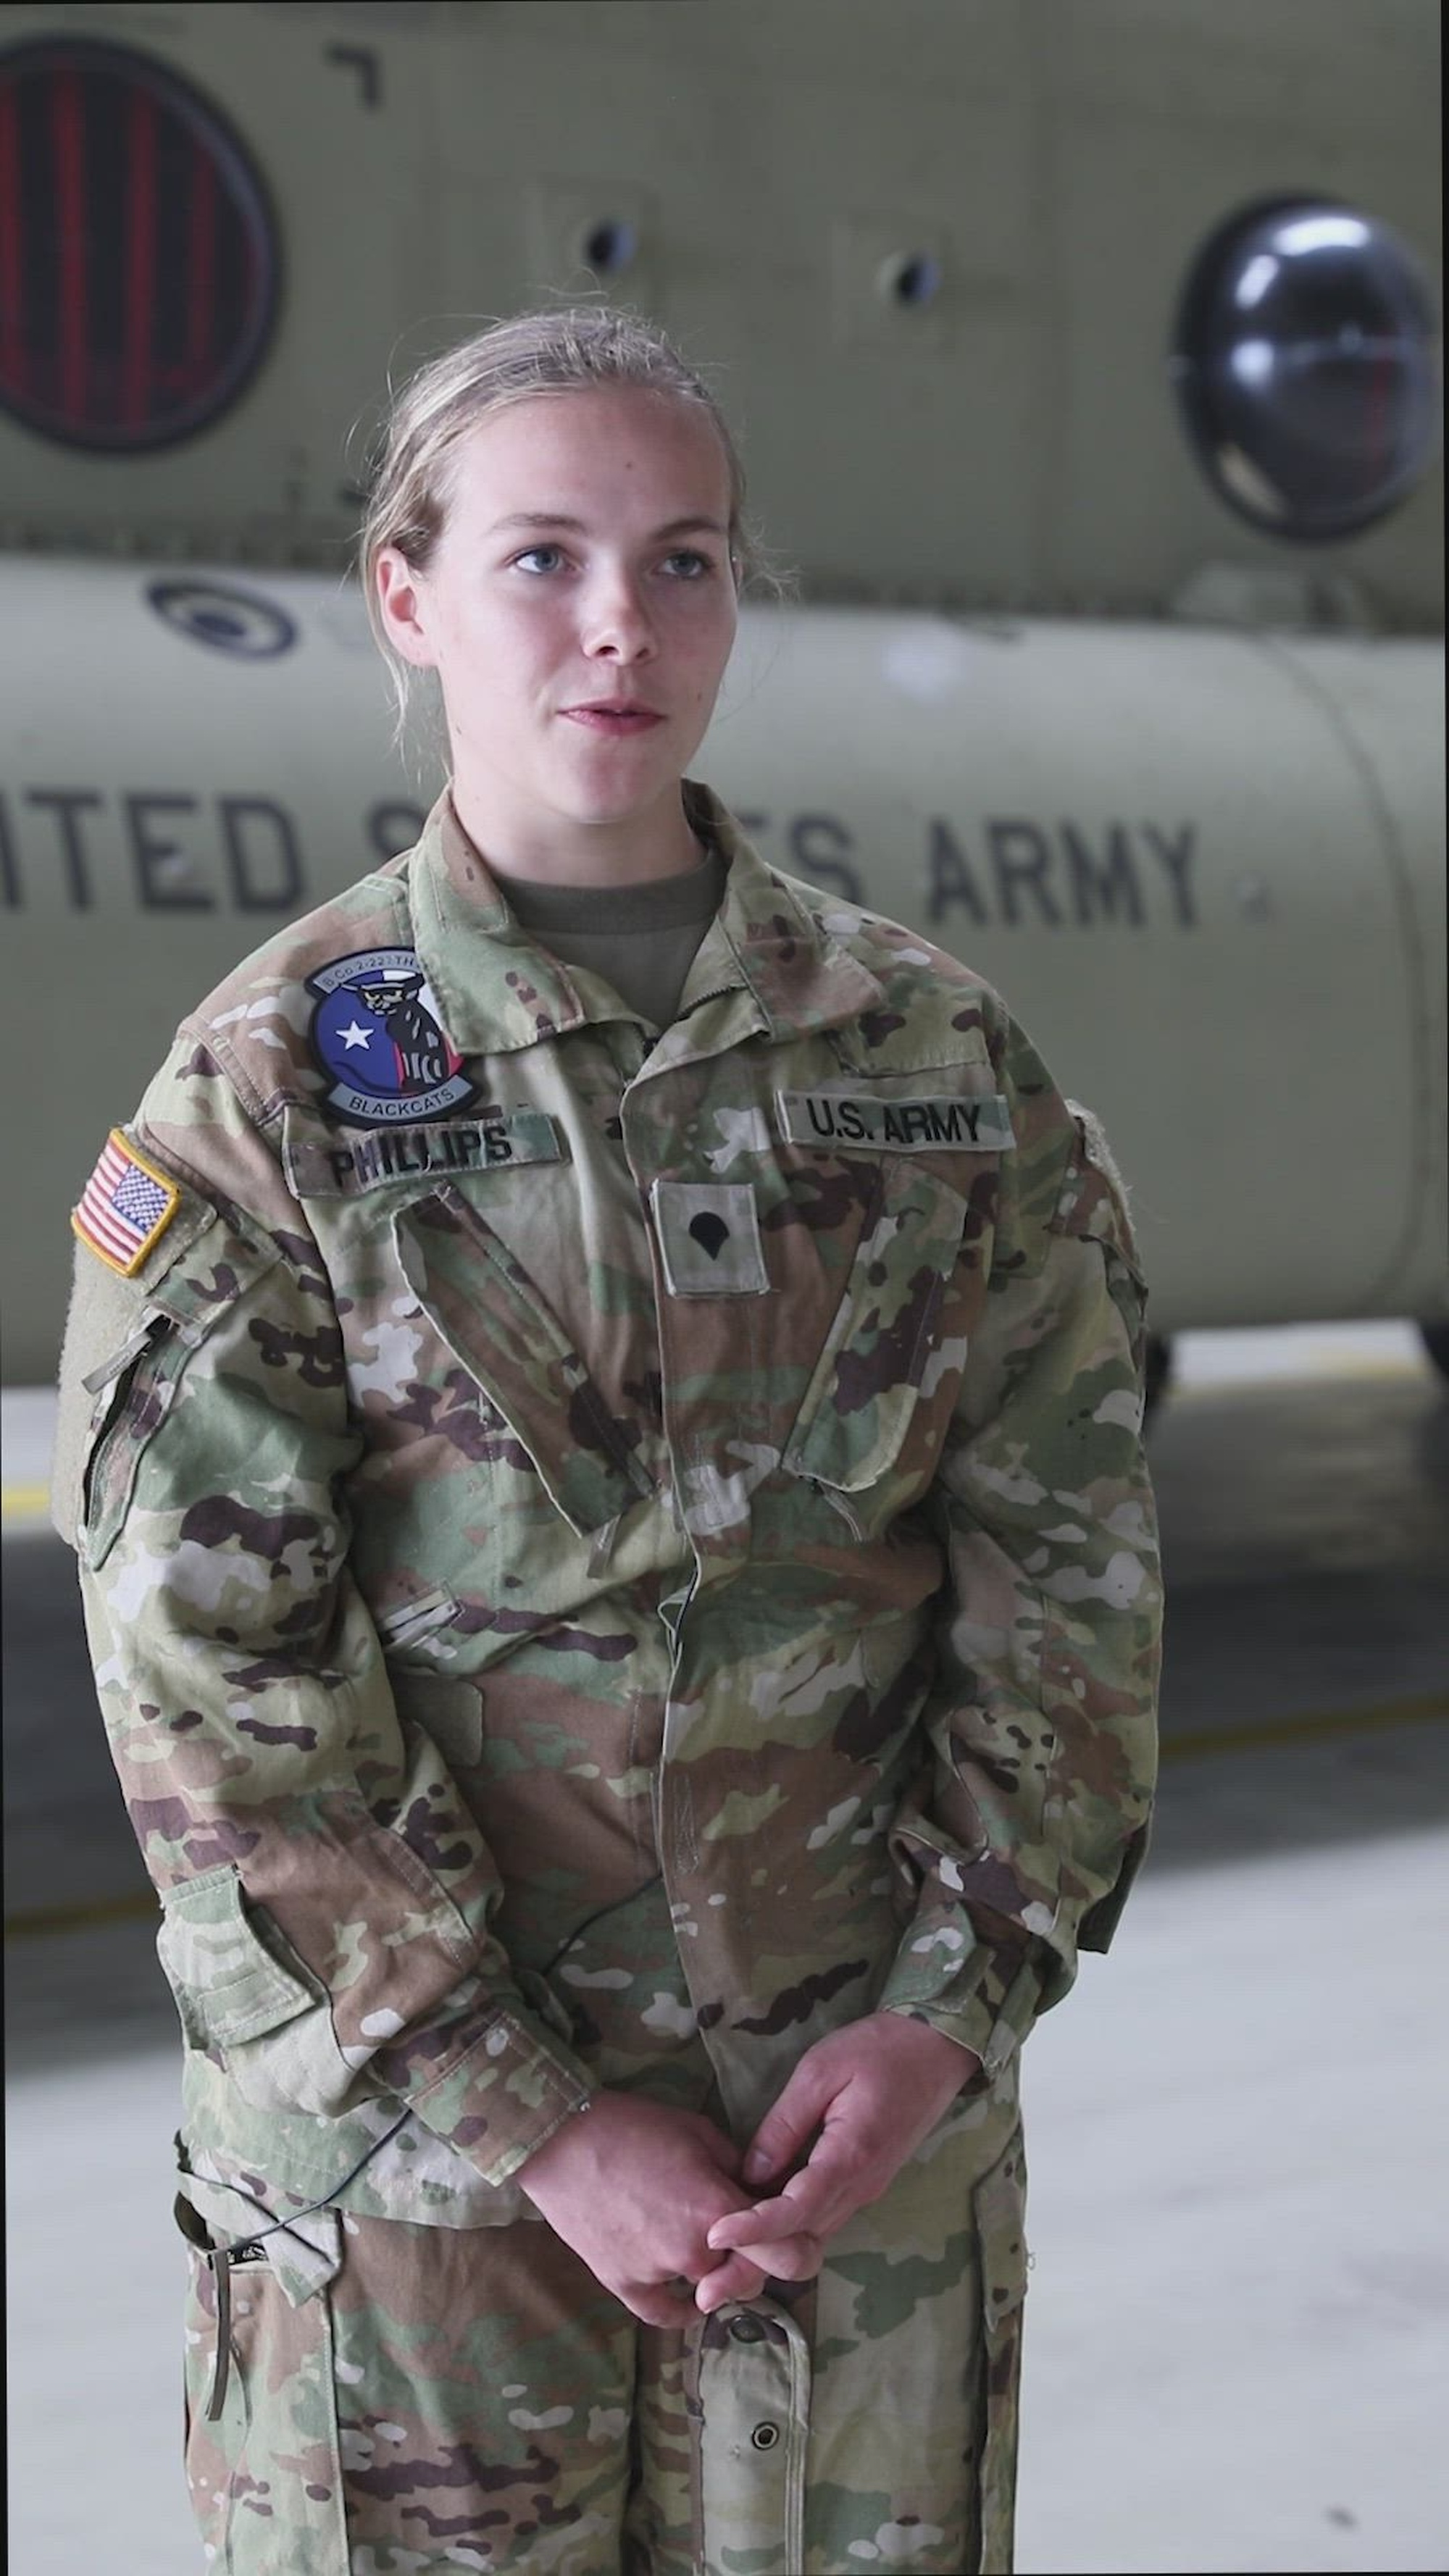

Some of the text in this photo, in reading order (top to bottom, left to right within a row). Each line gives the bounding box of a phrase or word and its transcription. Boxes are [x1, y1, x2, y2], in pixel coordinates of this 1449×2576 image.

[926, 813, 1200, 929] ARMY
[348, 1087, 454, 1116] BLACKCATS
[806, 1098, 980, 1144] U.S. ARMY
[330, 1124, 512, 1187] PHILLIPS
